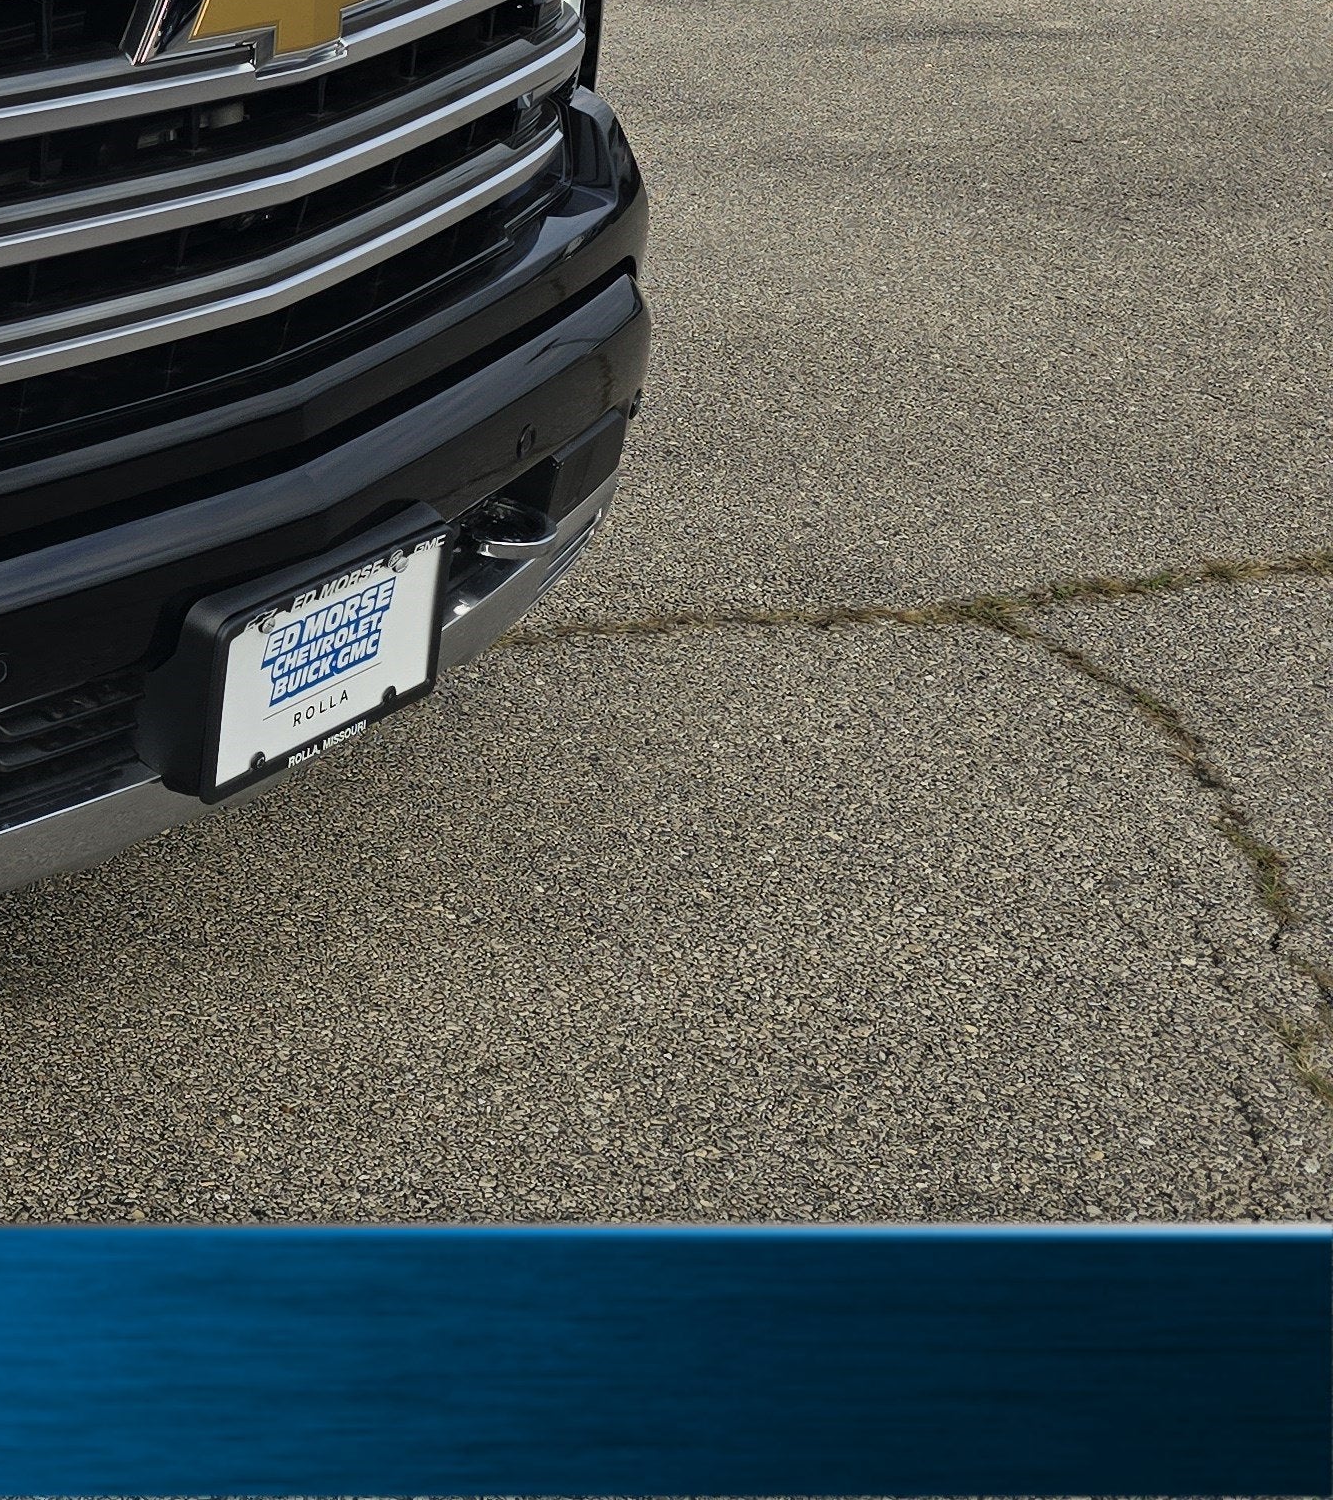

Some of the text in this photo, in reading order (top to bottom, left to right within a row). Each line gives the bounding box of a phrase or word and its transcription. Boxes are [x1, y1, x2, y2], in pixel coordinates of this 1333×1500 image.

[290, 534, 447, 614] ED MORSE GMC
[263, 578, 395, 663] ED MORSE
[293, 689, 349, 728] ROLLA
[322, 719, 367, 751] MISSOURI
